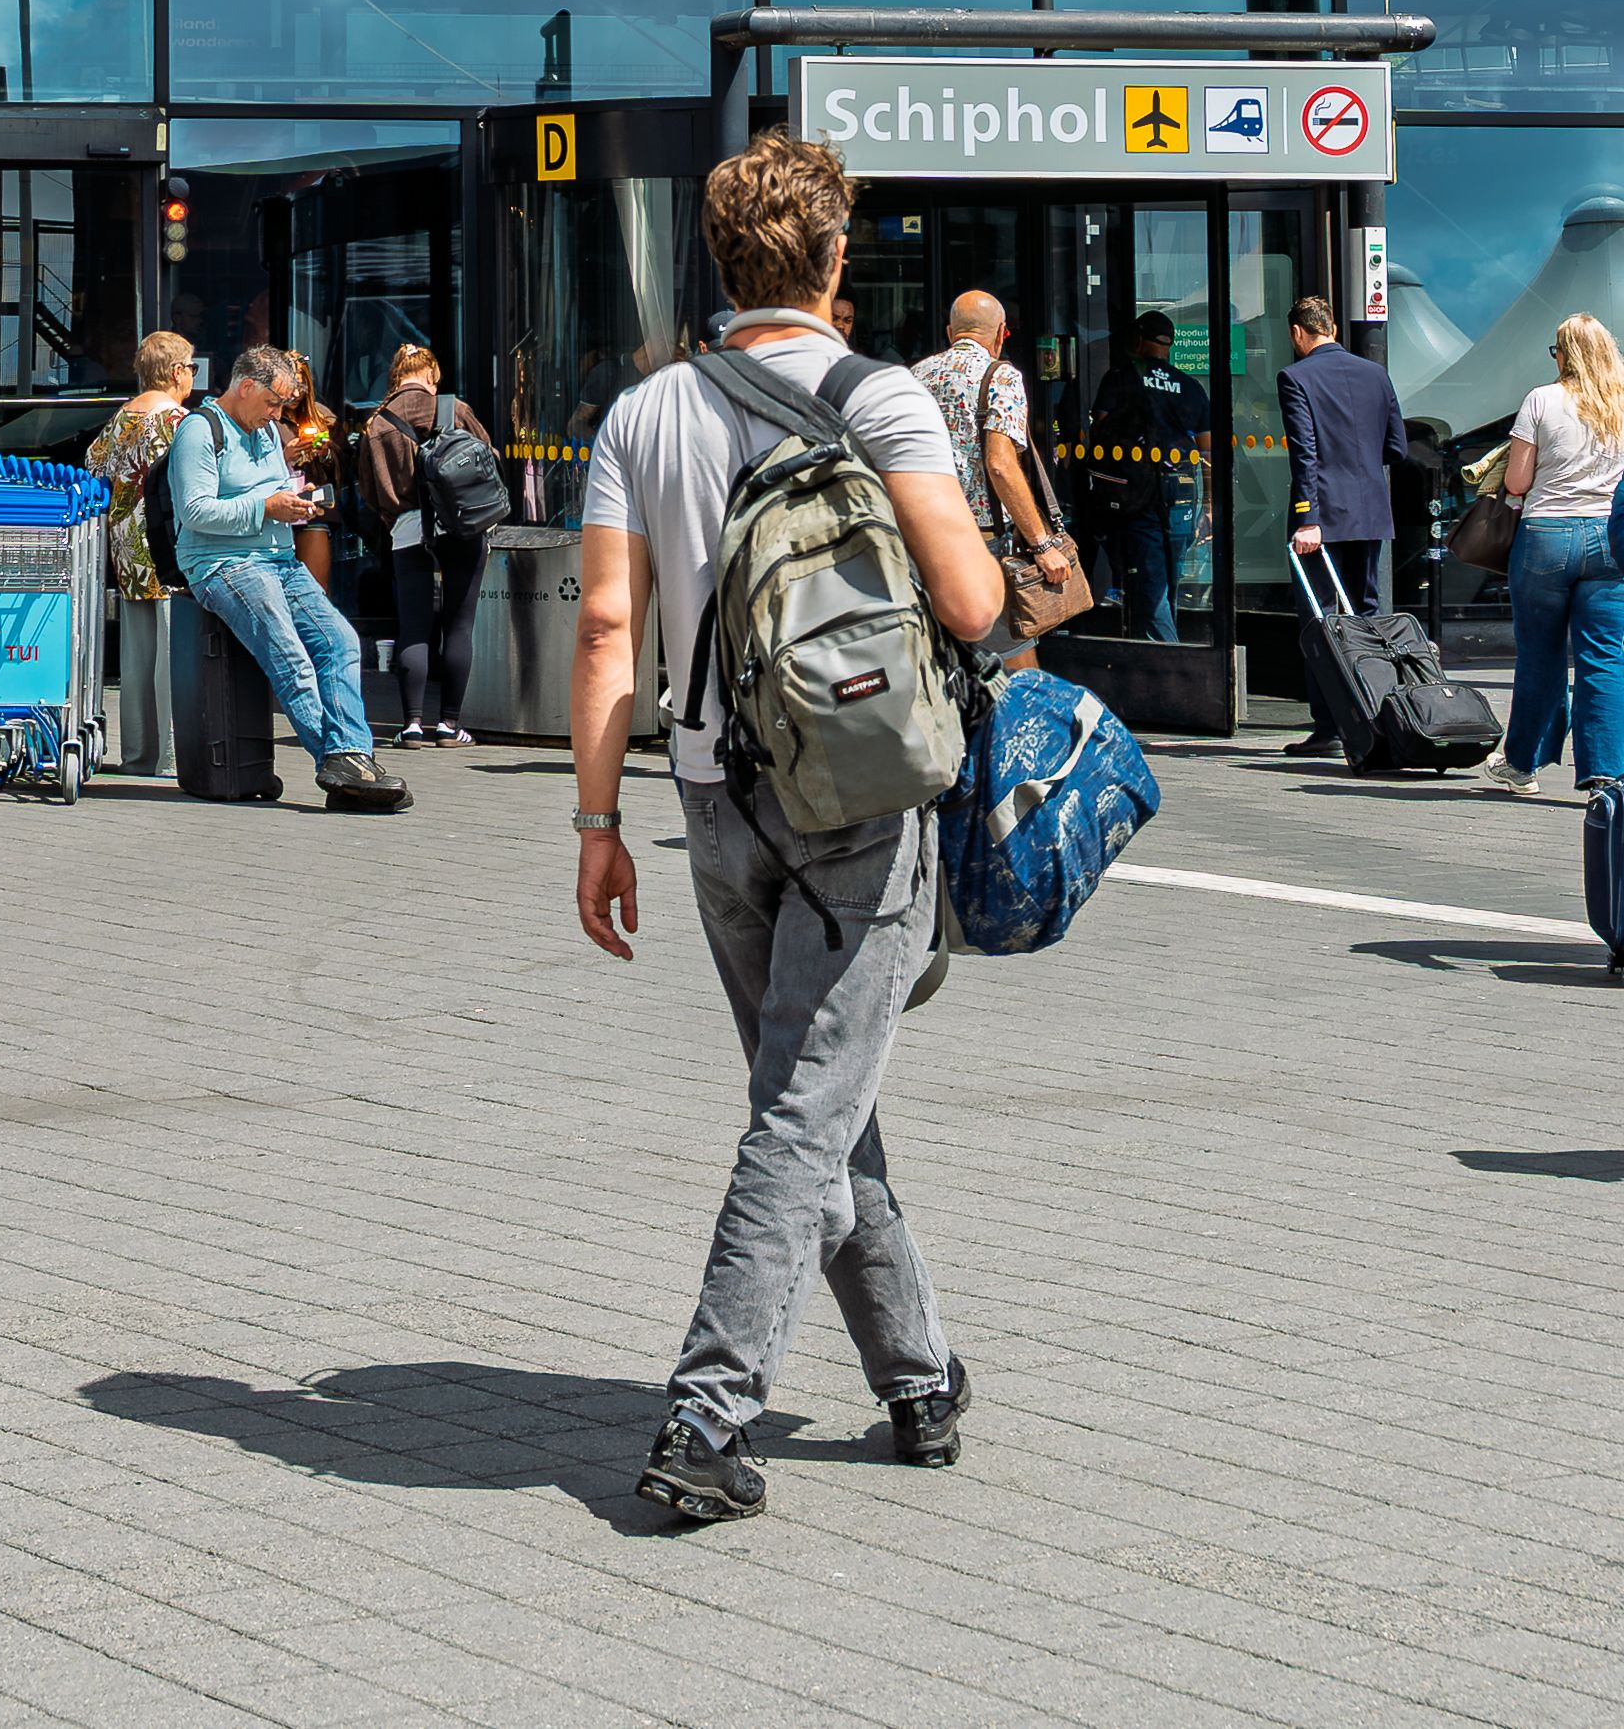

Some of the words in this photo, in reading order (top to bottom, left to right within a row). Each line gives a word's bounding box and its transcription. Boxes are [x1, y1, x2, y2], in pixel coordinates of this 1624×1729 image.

[824, 85, 1107, 157] Schiphol
[543, 122, 568, 171] D
[1173, 337, 1210, 348] vrijhoud
[1142, 375, 1182, 394] KLM
[501, 589, 511, 600] to
[513, 589, 550, 603] recycle
[4, 645, 39, 661] TUI
[841, 677, 882, 695] EASTPAK
